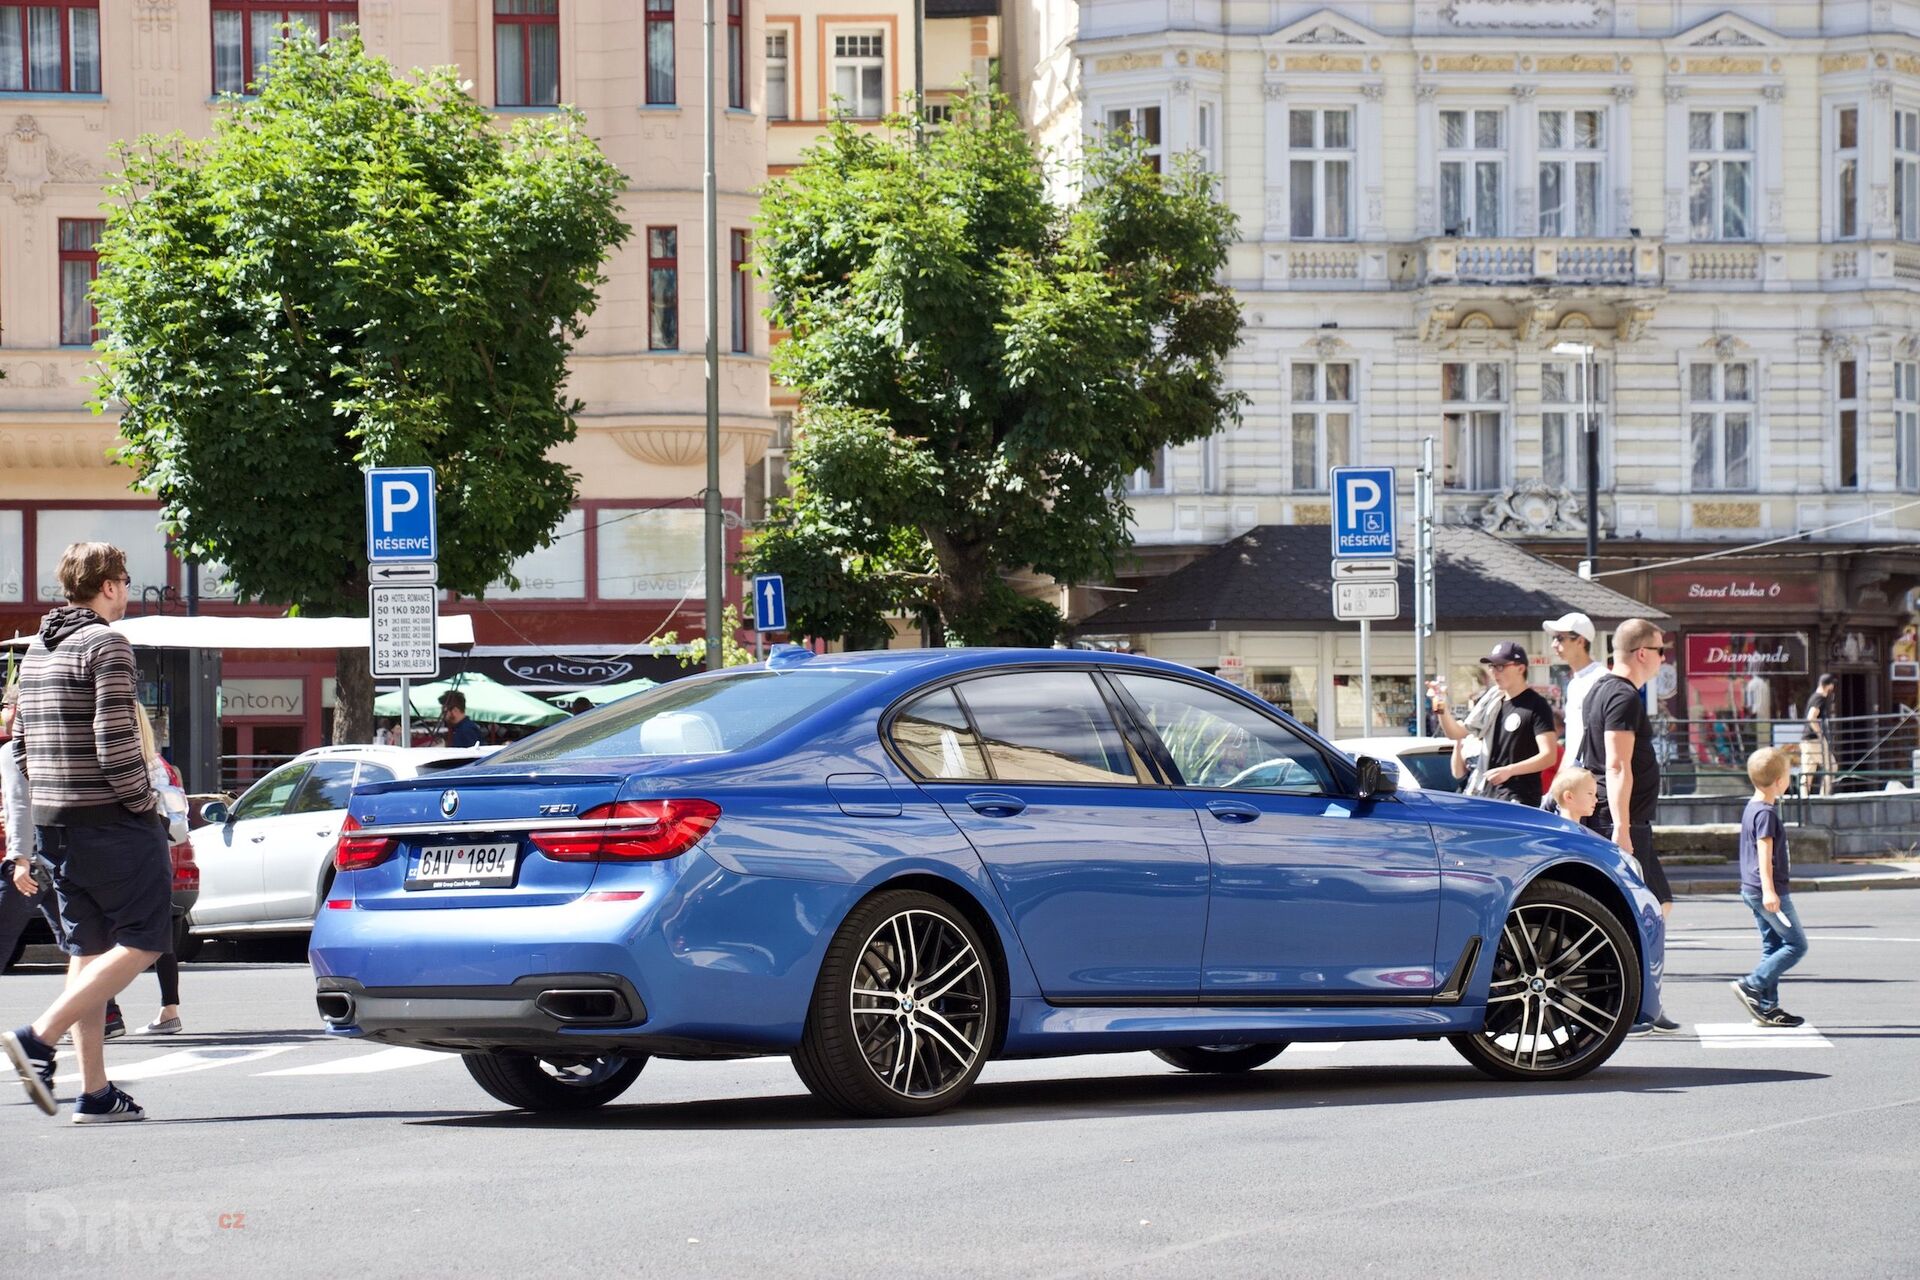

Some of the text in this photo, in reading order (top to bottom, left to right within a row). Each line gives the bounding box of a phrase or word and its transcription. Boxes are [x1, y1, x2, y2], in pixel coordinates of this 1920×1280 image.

[382, 481, 419, 532] P
[1346, 479, 1381, 529] P
[375, 535, 430, 550] RÉSERVÉ
[1340, 533, 1391, 546] RÉSERVÉ
[1688, 583, 1728, 597] Stará
[1729, 582, 1765, 597] louka
[377, 594, 389, 603] 49
[377, 606, 389, 615] 50
[377, 618, 388, 627] 51
[378, 633, 389, 642] 52
[378, 650, 389, 658] 53
[1705, 645, 1789, 663] Diamonds
[378, 660, 389, 668] 54
[518, 662, 628, 677] antony
[422, 848, 505, 875] 6AV 1894
[409, 869, 417, 877] CZ
